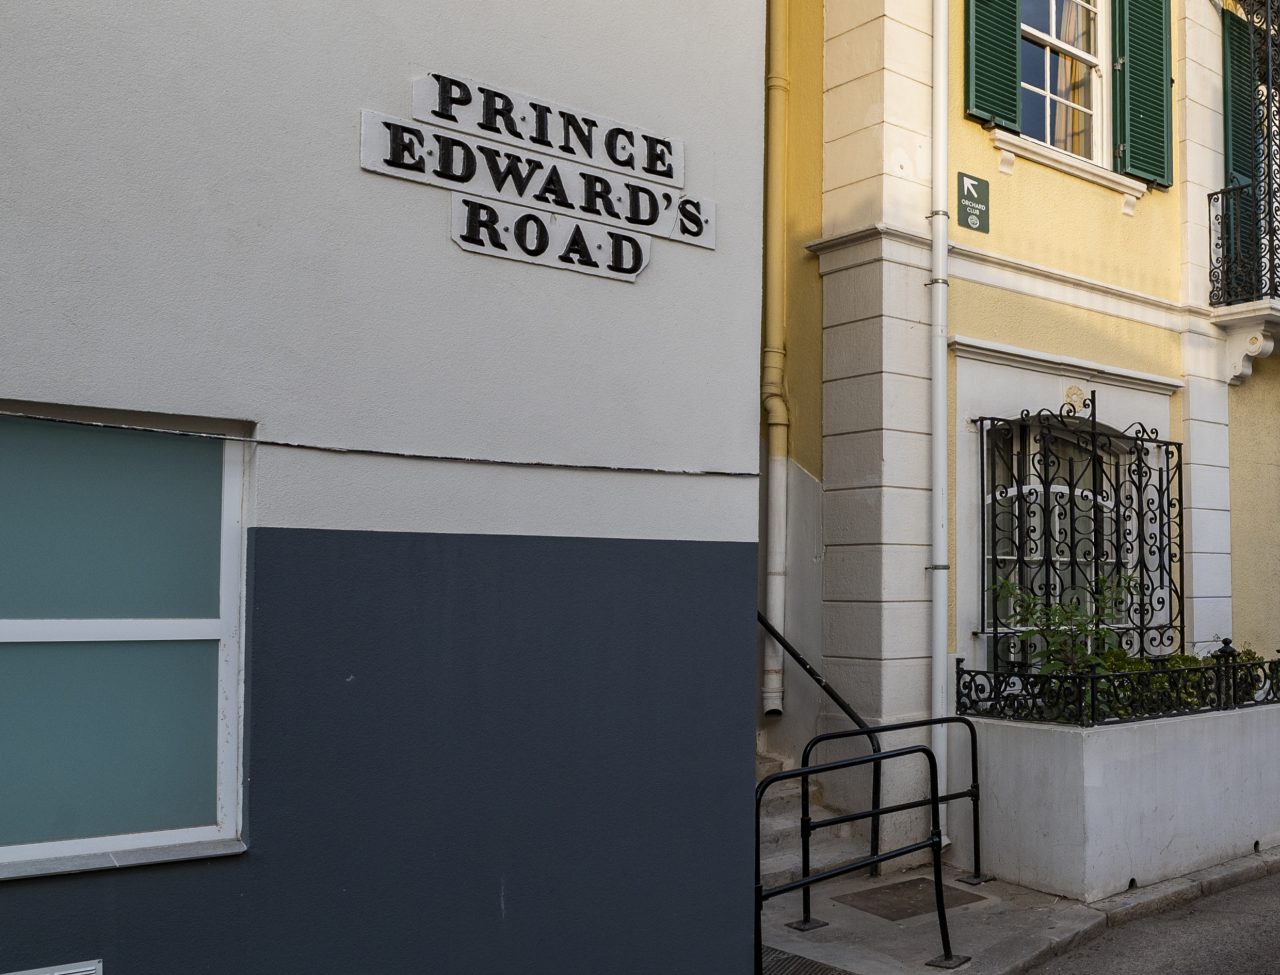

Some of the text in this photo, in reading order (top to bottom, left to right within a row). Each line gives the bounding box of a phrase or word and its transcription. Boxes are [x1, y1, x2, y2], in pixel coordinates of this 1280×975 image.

[430, 73, 674, 179] PRINCE
[381, 120, 705, 238] EDWARD'S
[961, 199, 986, 211] ORCHARD
[966, 207, 980, 216] CLUB
[459, 198, 644, 276] ROAD
